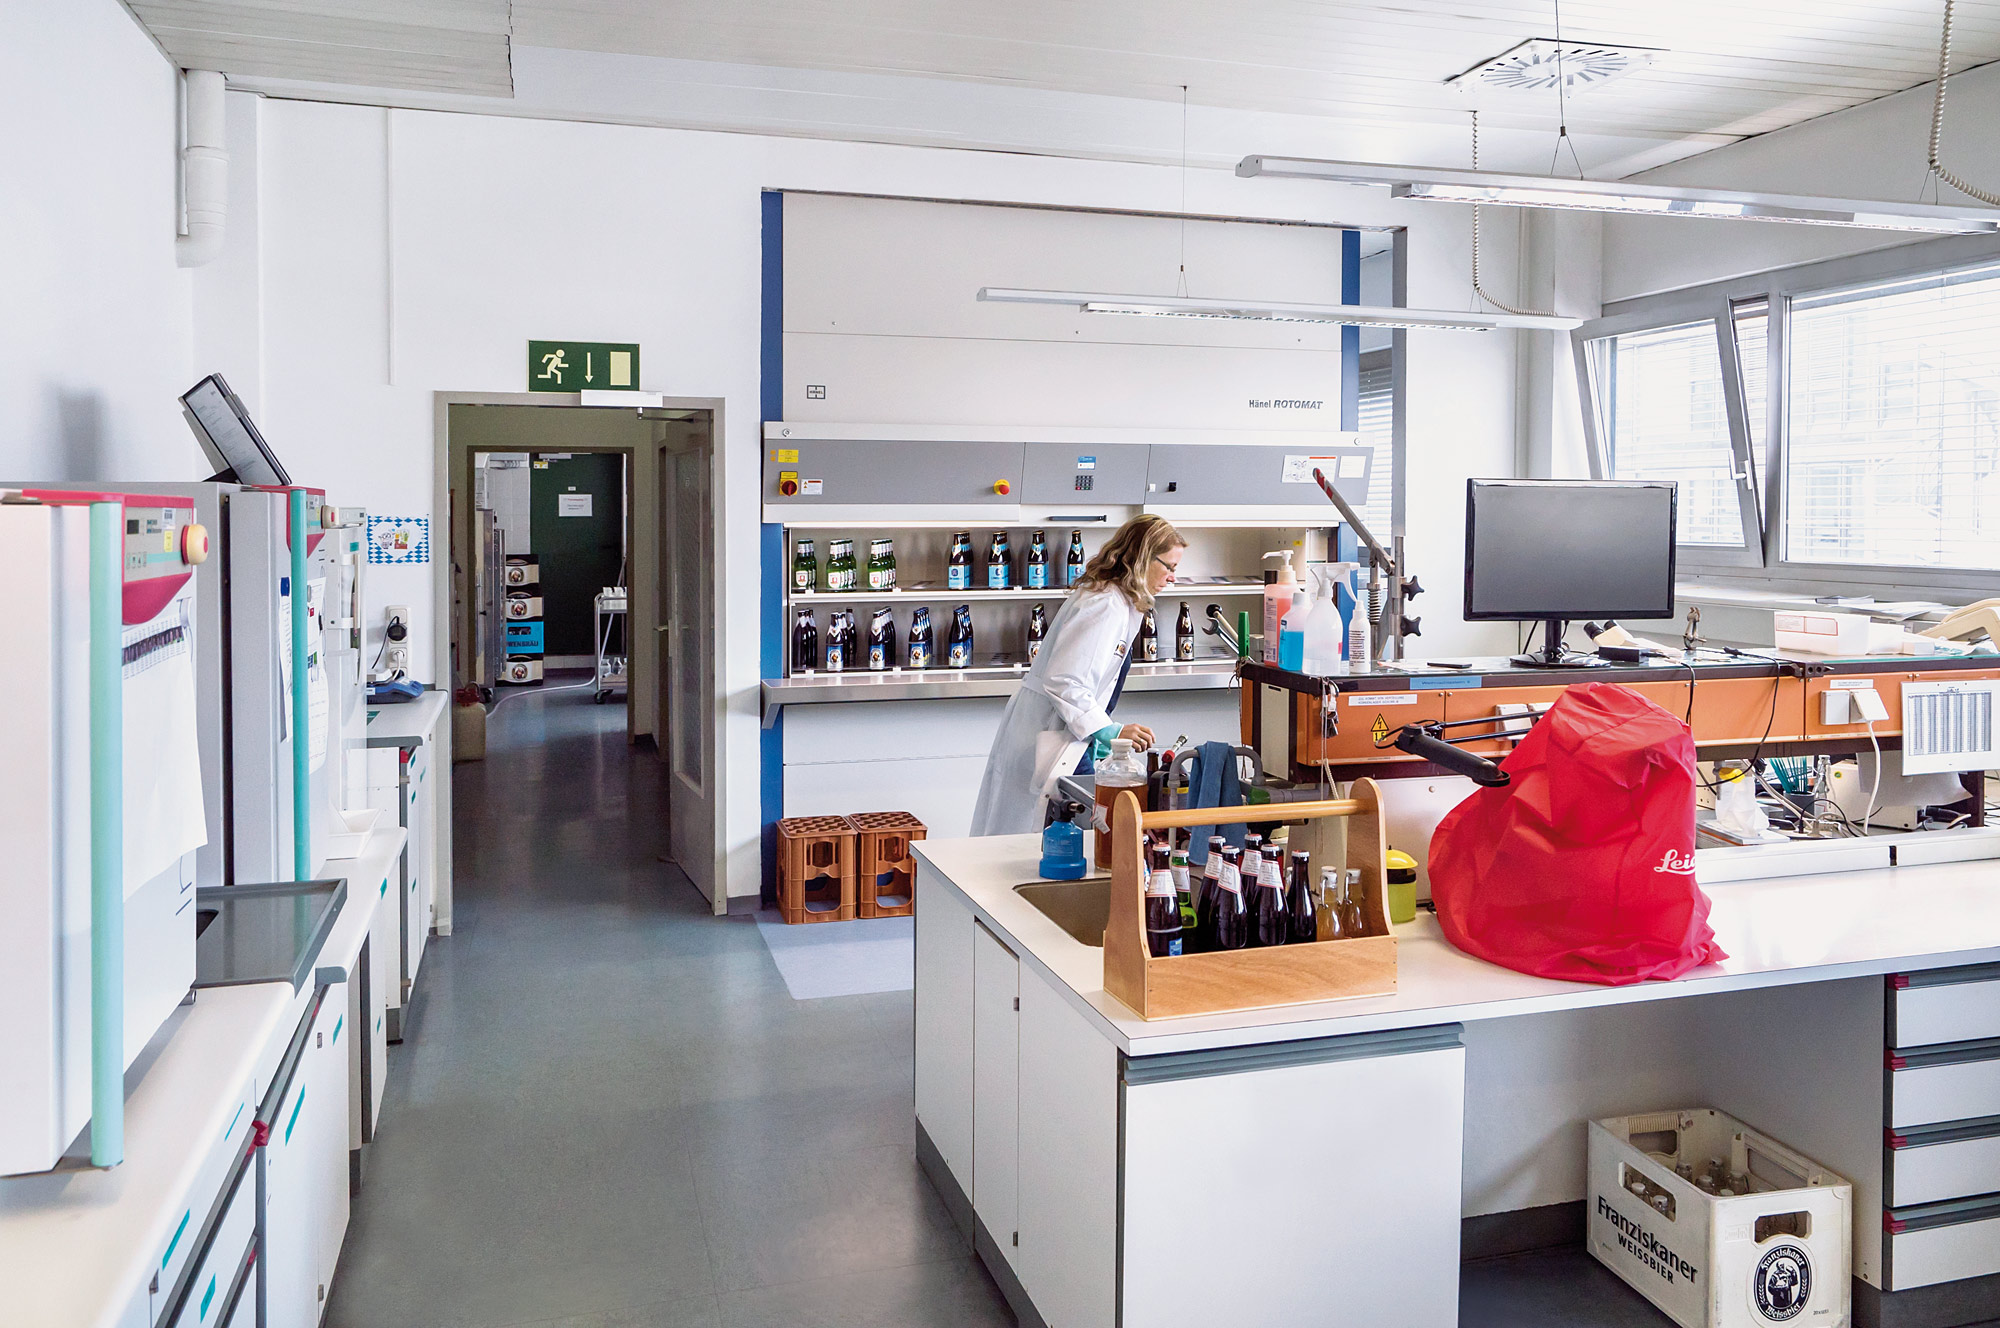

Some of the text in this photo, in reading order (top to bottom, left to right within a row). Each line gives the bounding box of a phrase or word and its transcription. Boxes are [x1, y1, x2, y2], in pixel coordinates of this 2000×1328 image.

[1248, 400, 1324, 409] Hänel ROTOMAT
[1598, 1195, 1698, 1283] Franziskaner
[1618, 1232, 1674, 1284] WEISSBIER
[1760, 1248, 1806, 1271] Franziskaner
